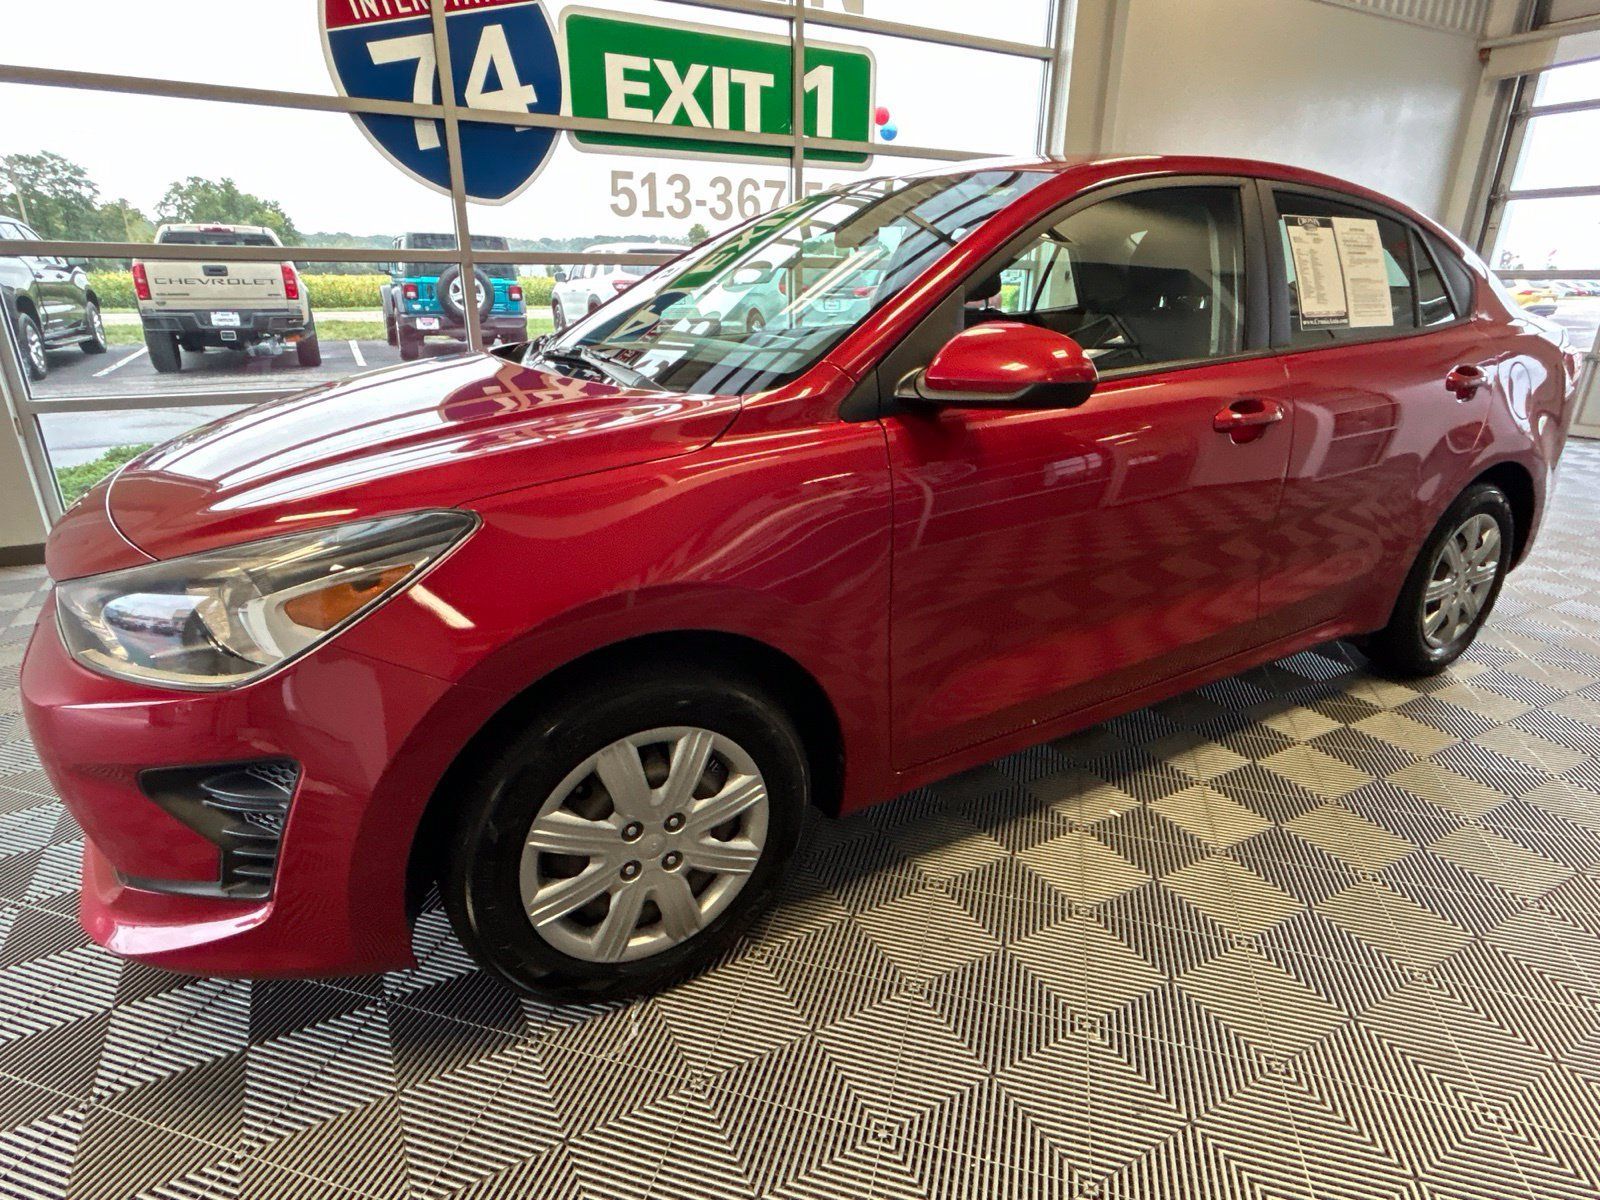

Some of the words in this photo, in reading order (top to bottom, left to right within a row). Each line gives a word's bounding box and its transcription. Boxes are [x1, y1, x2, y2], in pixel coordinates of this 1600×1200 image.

[366, 24, 538, 151] 74
[604, 52, 774, 134] EXIT
[803, 64, 833, 138] 1
[154, 278, 277, 286] CHEVROLET
